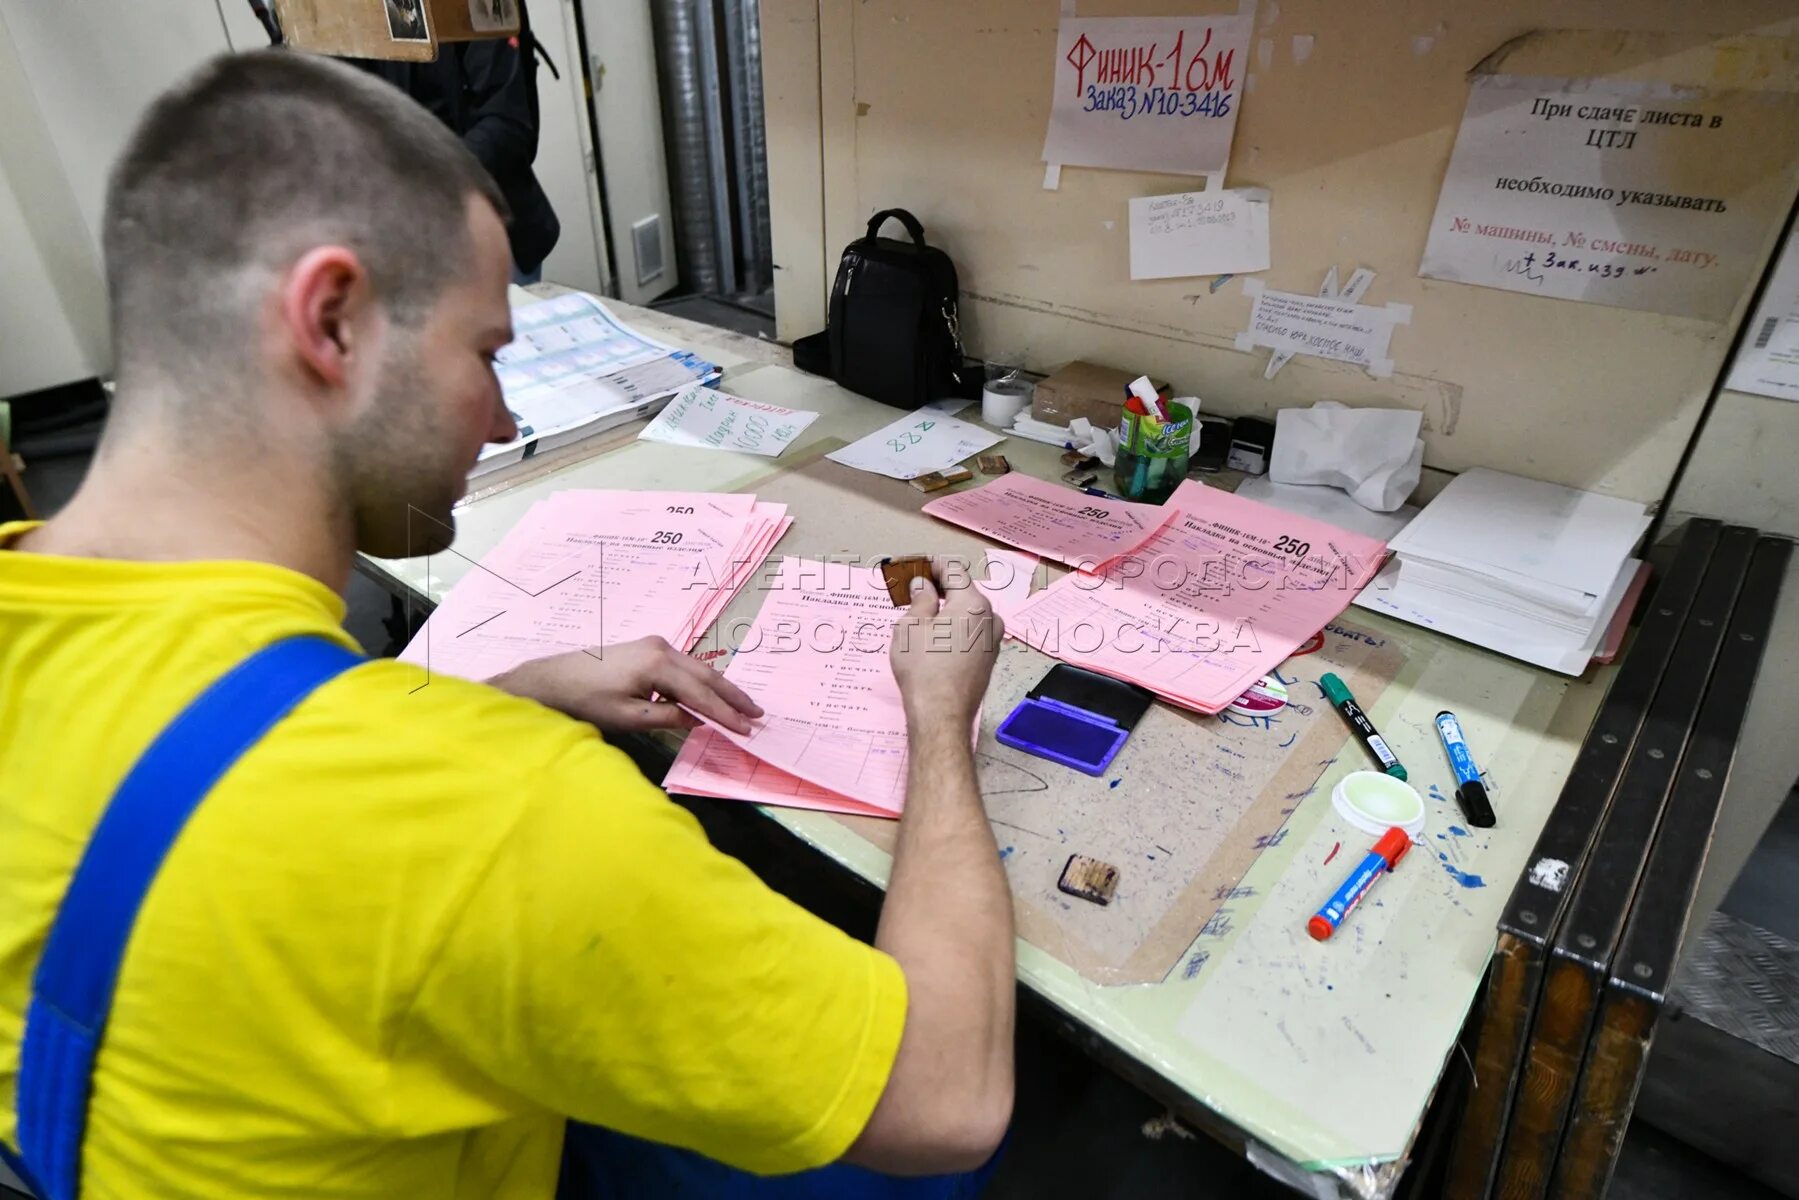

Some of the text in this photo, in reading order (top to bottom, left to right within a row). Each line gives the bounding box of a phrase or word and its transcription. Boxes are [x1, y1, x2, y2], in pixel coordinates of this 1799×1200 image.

[1067, 28, 1234, 98] Финик-16м
[1084, 85, 1137, 120] Заказ
[1530, 98, 1571, 120] При
[1640, 109, 1703, 128] листа
[1709, 114, 1723, 128] в
[1586, 129, 1637, 149] ЦТЛ
[1496, 175, 1727, 214] необходимо указывать
[1450, 216, 1719, 269] № машины, № смены, дату.
[1078, 506, 1109, 519] 250
[650, 531, 683, 545] 250
[1184, 520, 1226, 541] Накладка
[1229, 537, 1240, 546] на
[1243, 543, 1287, 561] основные
[1273, 535, 1310, 558] 250
[802, 595, 849, 606] Накладка
